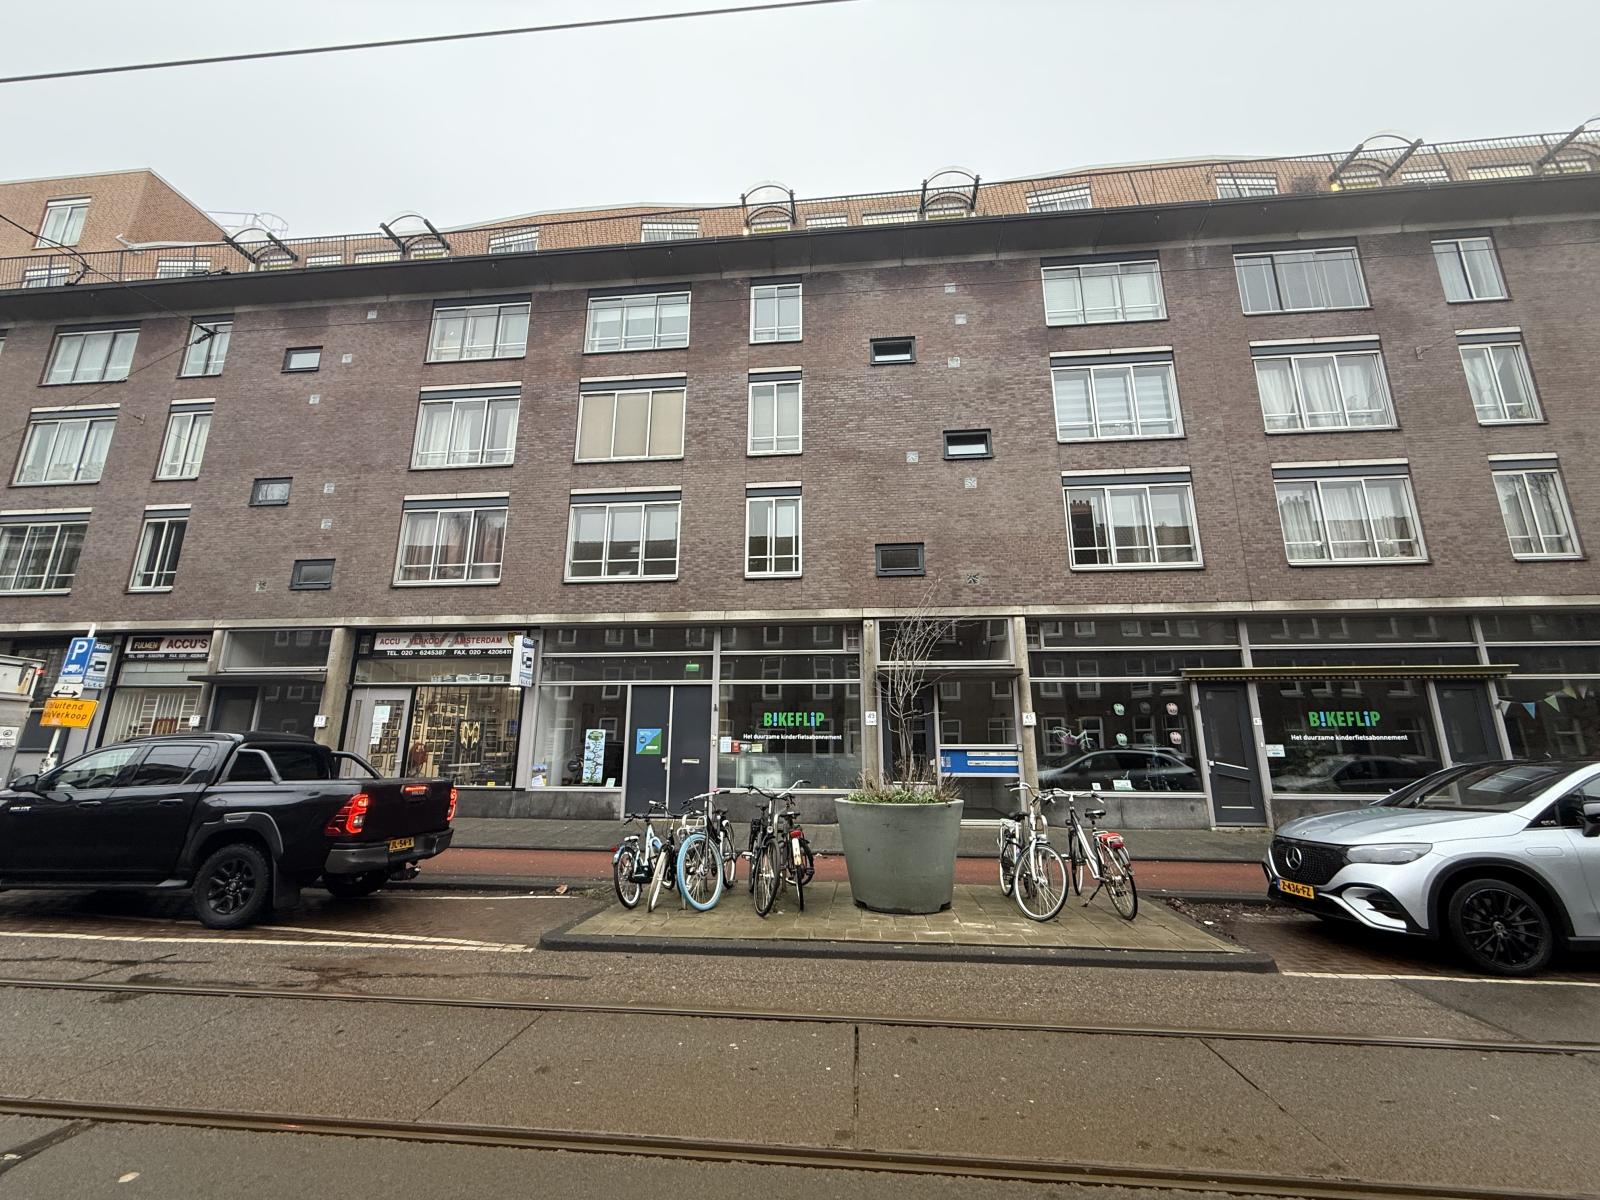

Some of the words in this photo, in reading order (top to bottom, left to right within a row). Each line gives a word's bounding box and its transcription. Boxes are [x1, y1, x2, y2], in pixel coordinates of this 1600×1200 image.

[134, 640, 158, 650] FULMEN
[166, 638, 209, 649] ACCU'S
[379, 637, 401, 646] ACCU
[408, 637, 445, 646] VERKOOP
[453, 636, 503, 645] AMSTERDAM
